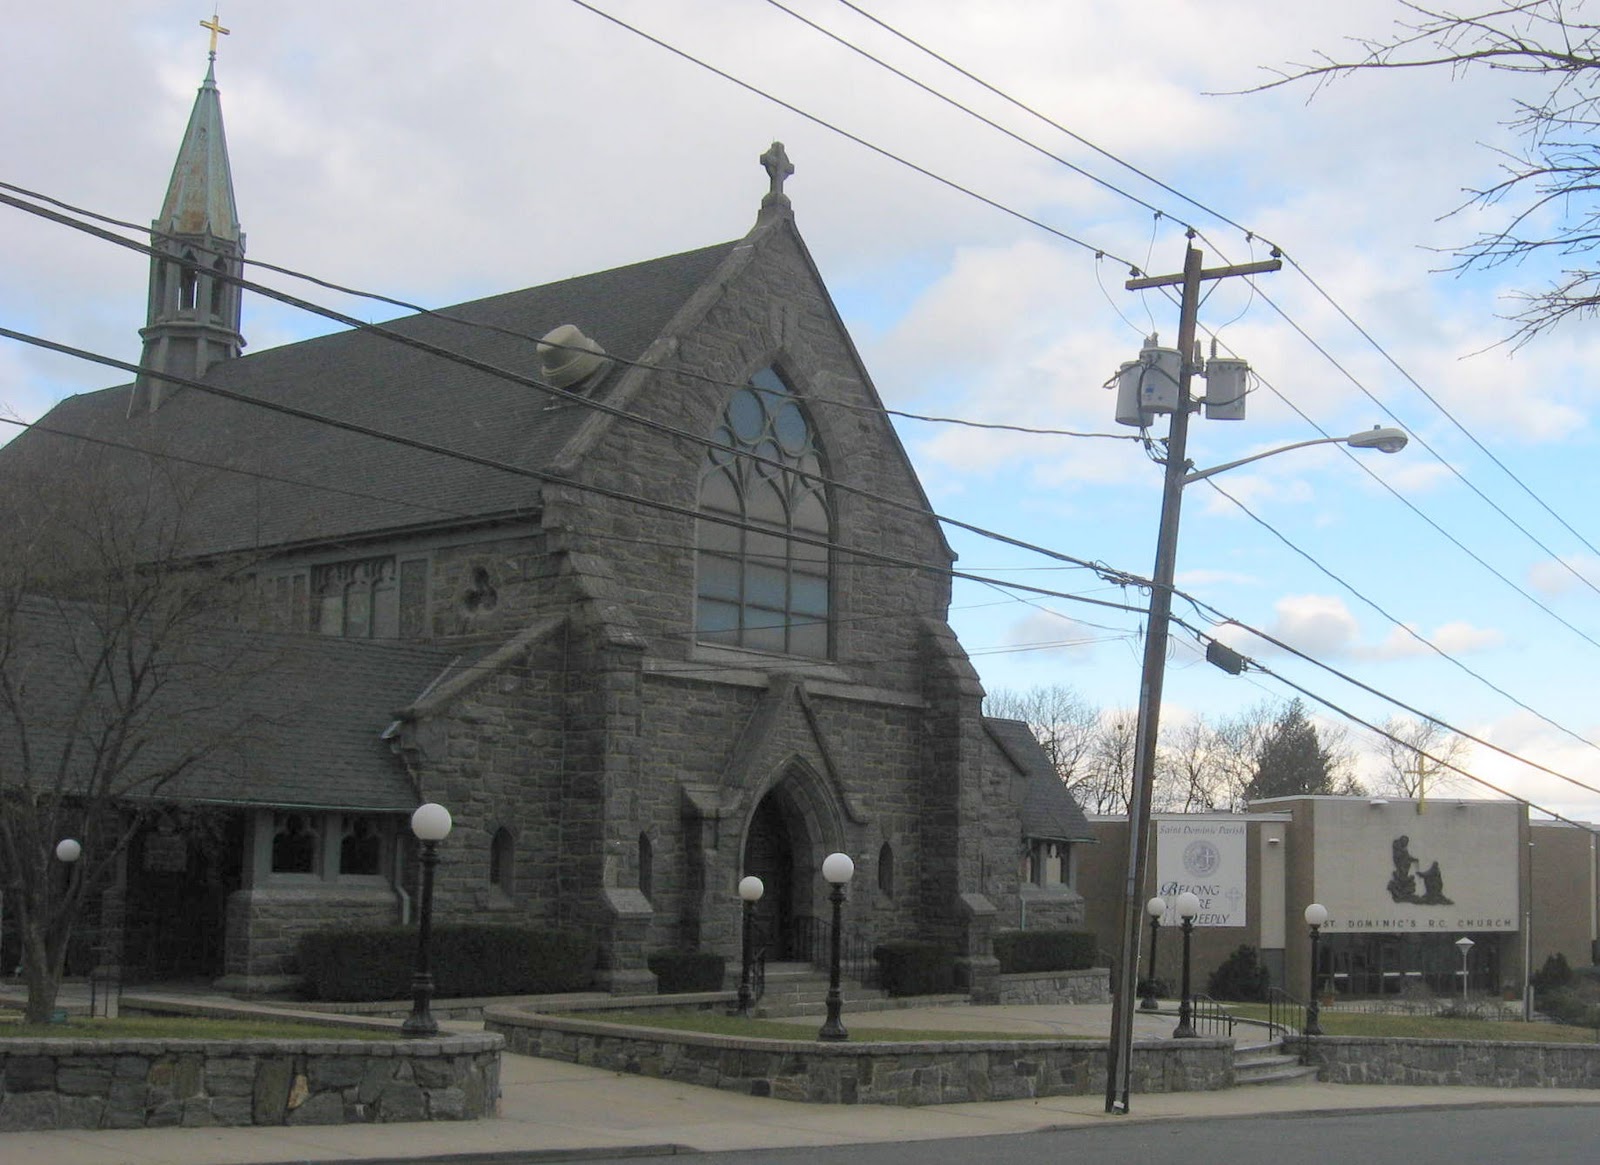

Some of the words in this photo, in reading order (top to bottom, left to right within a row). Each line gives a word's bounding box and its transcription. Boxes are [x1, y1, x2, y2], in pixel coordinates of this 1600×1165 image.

[1160, 825, 1182, 834] Saint
[1219, 825, 1245, 835] Parish
[1348, 919, 1416, 928] DOMINIC'S
[1457, 919, 1511, 928] CHURCH
